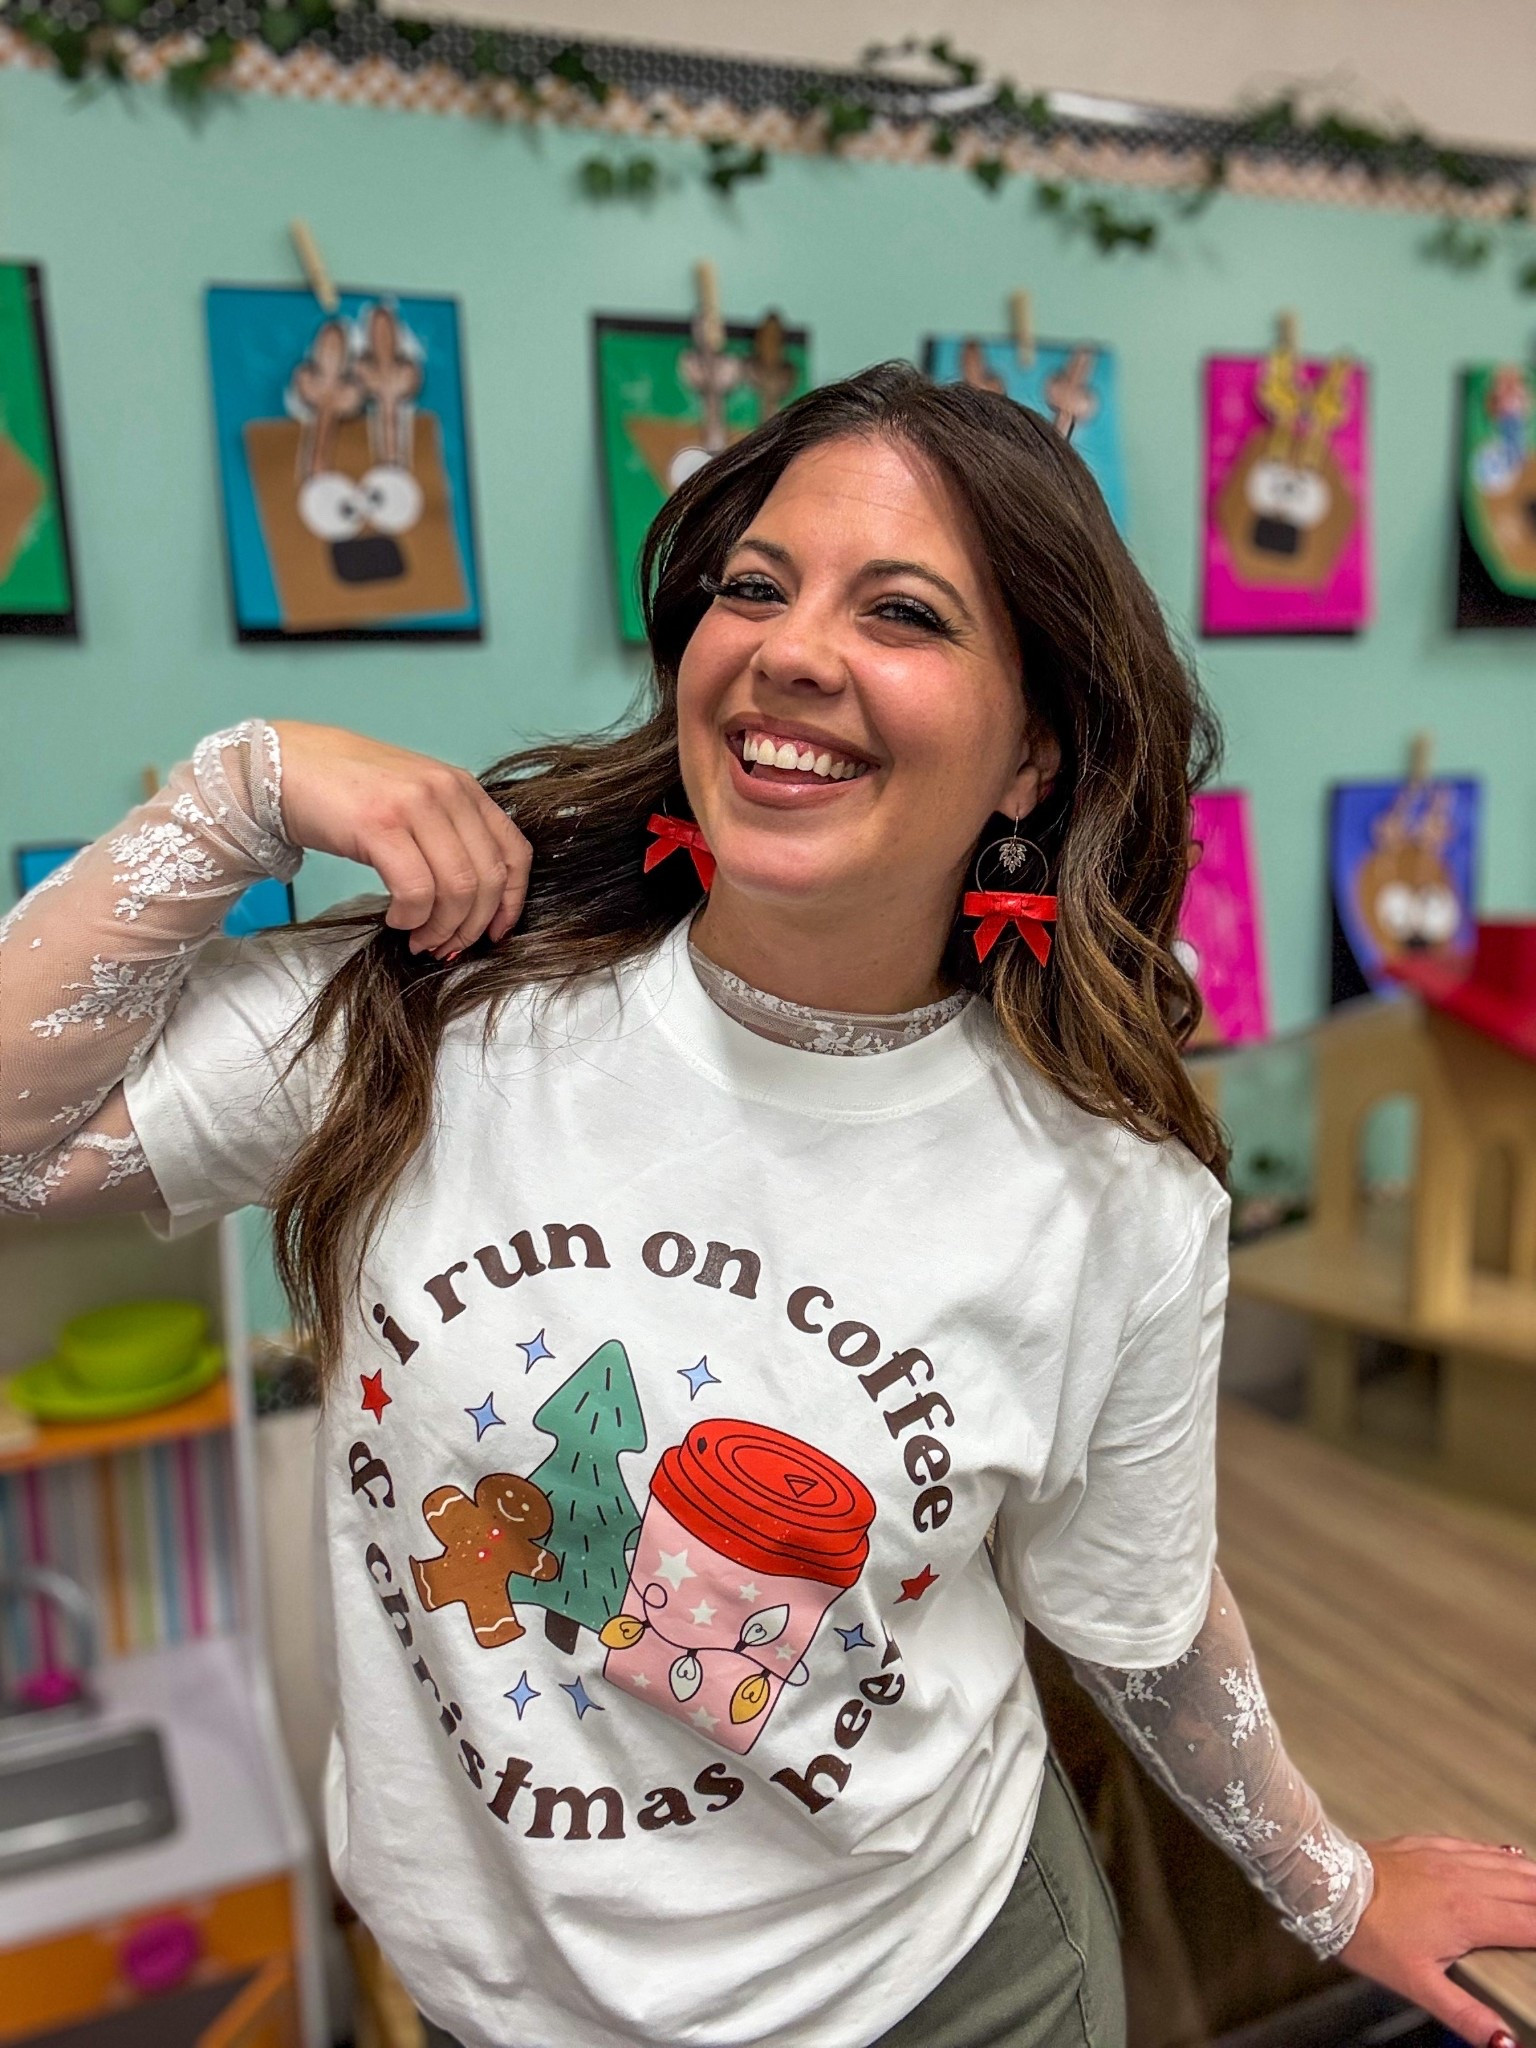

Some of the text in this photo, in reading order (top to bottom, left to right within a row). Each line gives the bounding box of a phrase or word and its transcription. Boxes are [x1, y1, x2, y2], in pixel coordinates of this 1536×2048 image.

[348, 1441, 396, 1509] &
[372, 1223, 955, 1533] i run on coffee
[365, 1542, 745, 1841] christmas
